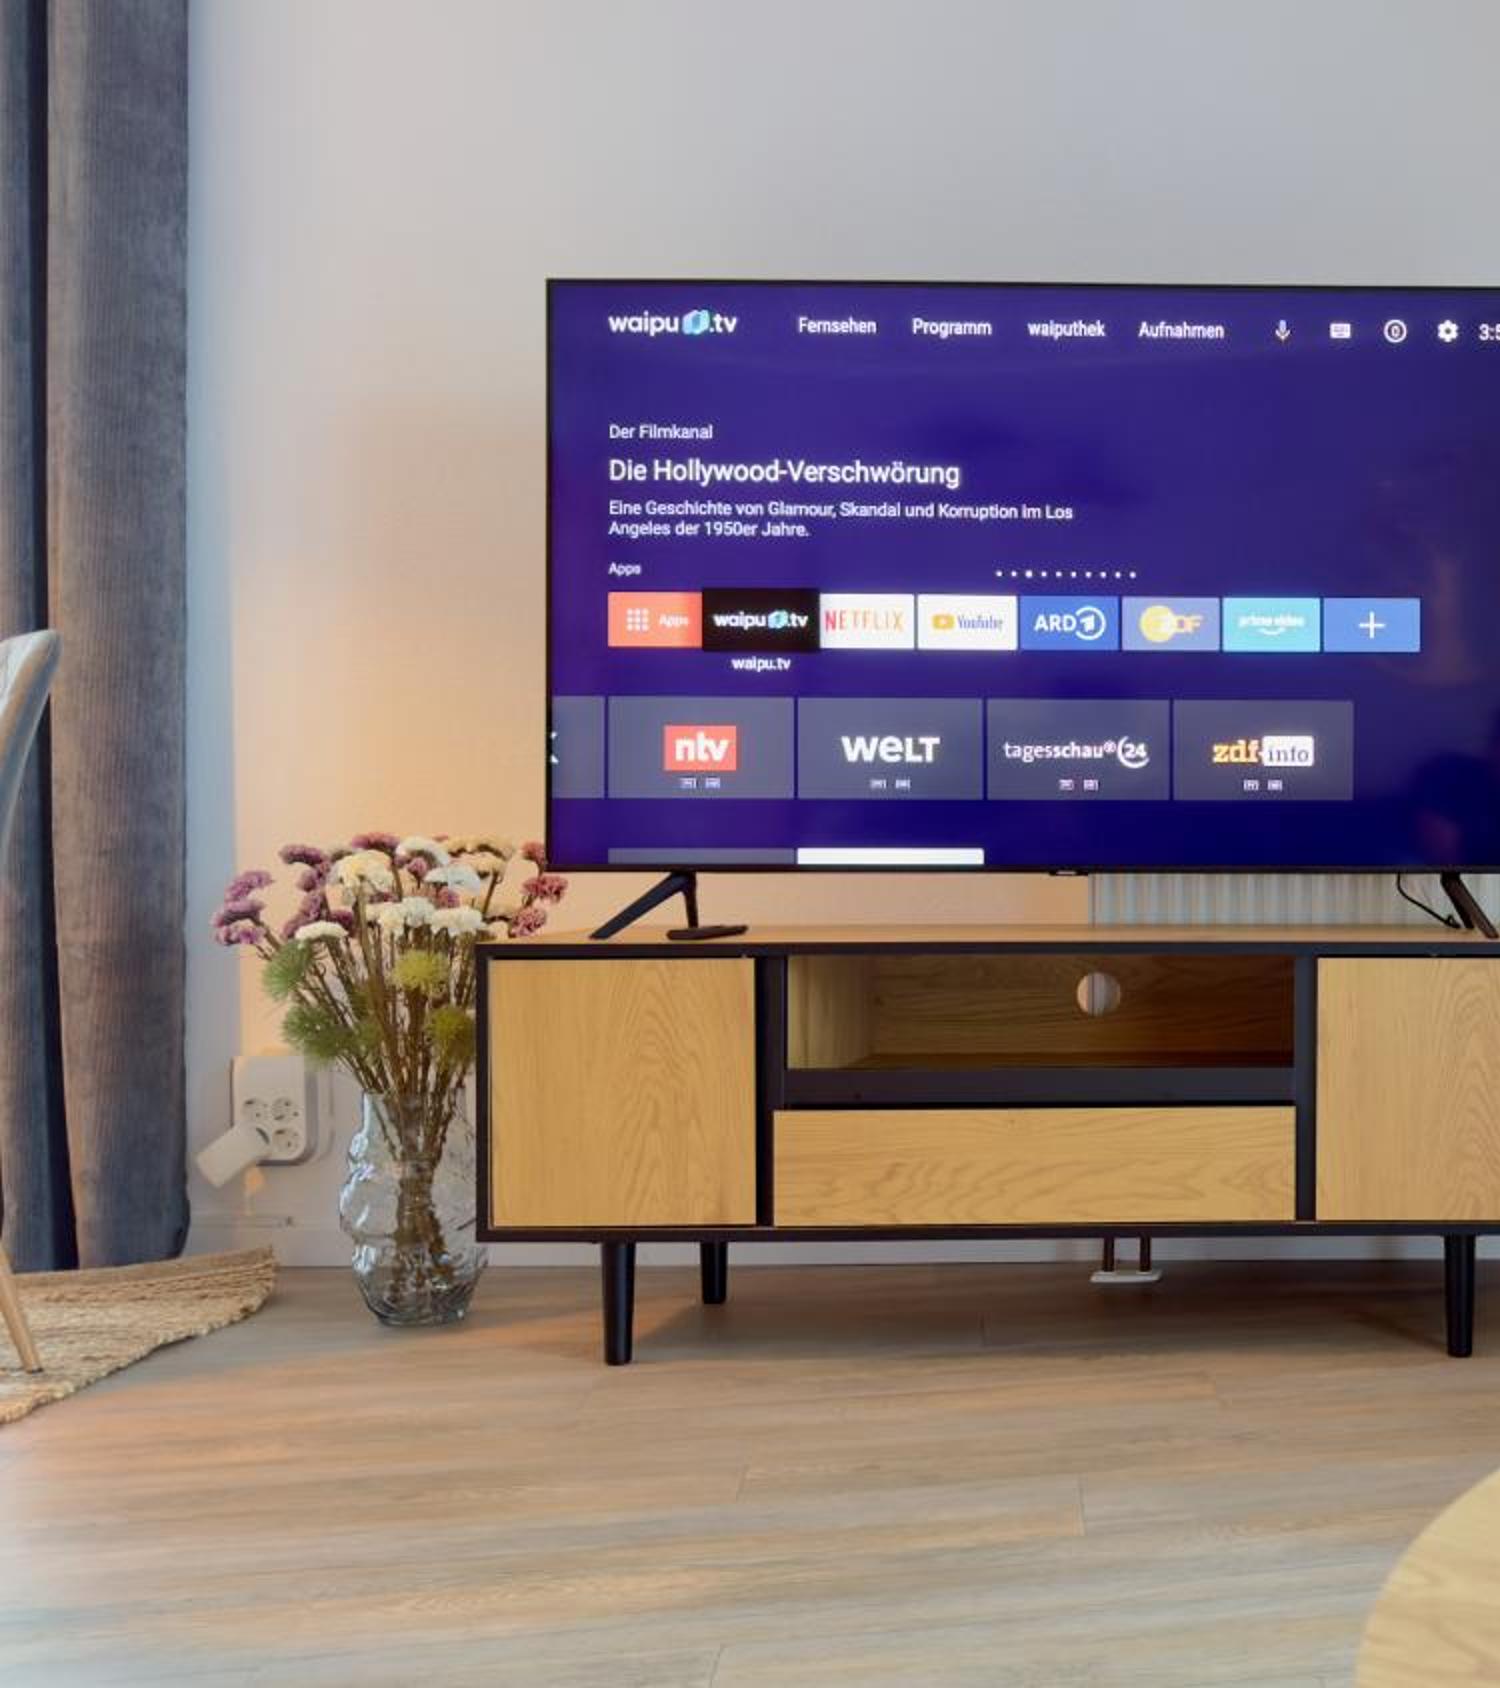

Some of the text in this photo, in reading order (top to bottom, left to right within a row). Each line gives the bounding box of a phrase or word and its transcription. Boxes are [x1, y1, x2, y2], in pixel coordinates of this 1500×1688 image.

[798, 317, 877, 335] Fernsehen
[911, 317, 993, 340] Programm
[1027, 319, 1106, 341] waiputhek
[1138, 319, 1225, 341] Aufnahmen
[609, 423, 714, 440] Der Filmkanal
[609, 458, 961, 488] Die Hollywood-Verschwörung
[609, 500, 1074, 521] Eine Geschichte von Glamour, Skandal und Korruption im Los
[608, 521, 810, 539] Angeles der 1950er Jahre.
[608, 562, 642, 577] Apps
[825, 610, 906, 632] NETFLIX
[1033, 614, 1077, 632] ARD
[731, 656, 792, 673] waipu.tv
[675, 731, 729, 763] ntv
[1004, 741, 1103, 763] tagesschau
